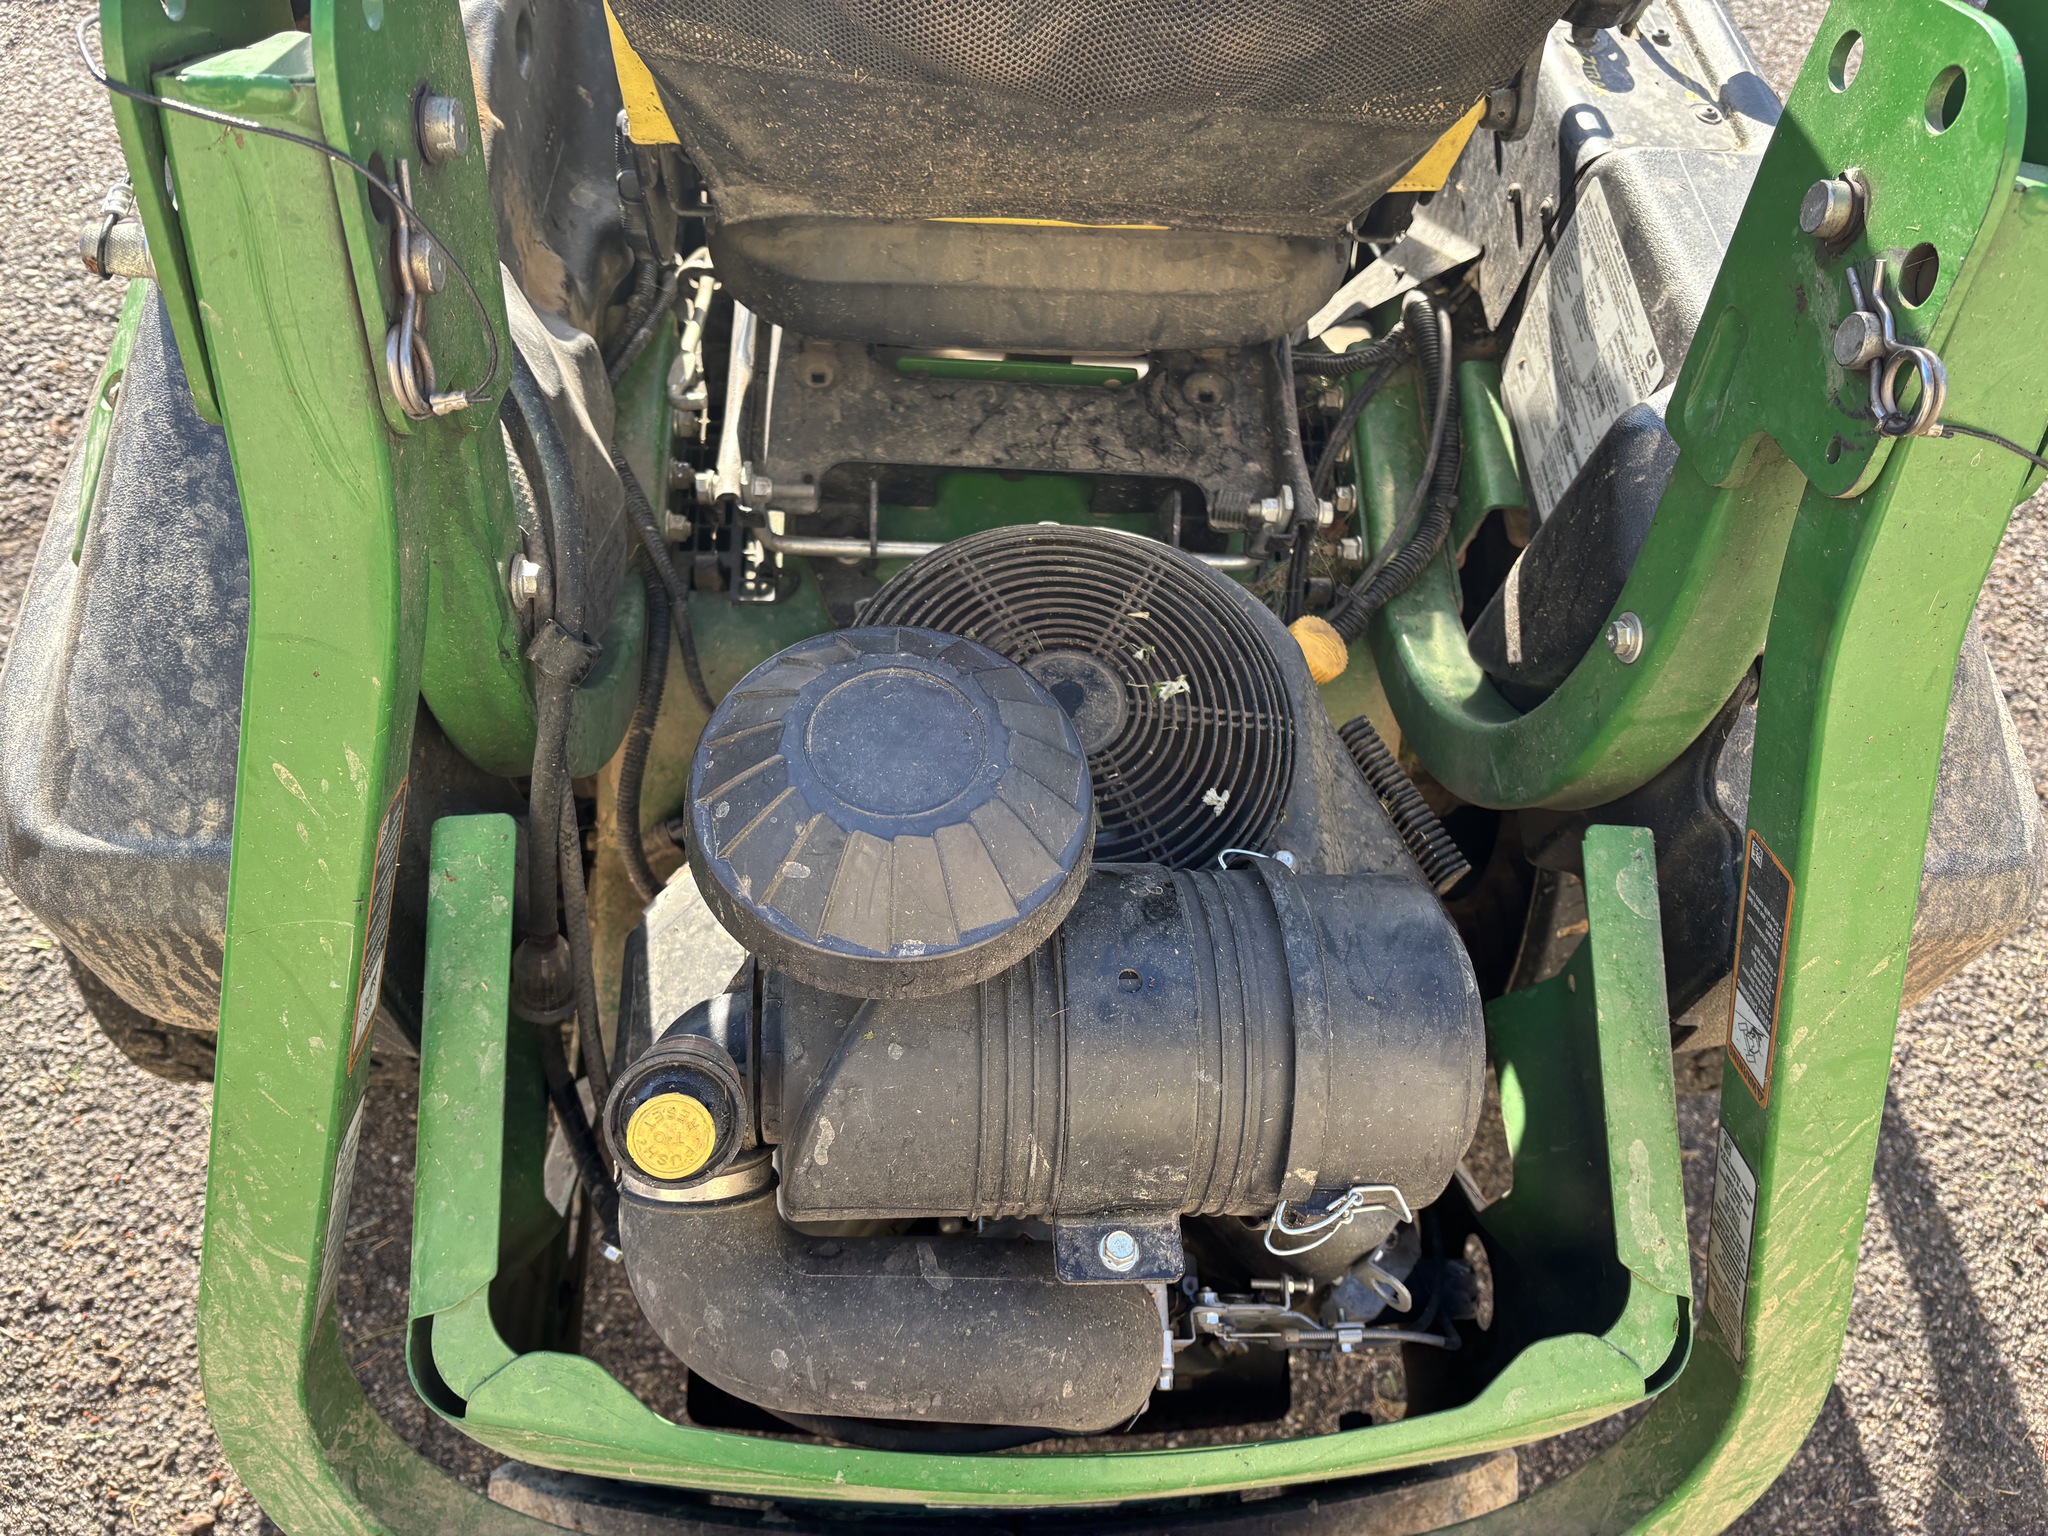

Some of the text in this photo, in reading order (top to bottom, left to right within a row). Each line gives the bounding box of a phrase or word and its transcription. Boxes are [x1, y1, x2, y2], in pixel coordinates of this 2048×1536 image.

[1729, 1043, 1758, 1096] WARNING
[643, 1106, 700, 1131] RESET
[653, 1130, 685, 1147] TO
[643, 1145, 695, 1167] PUSH
